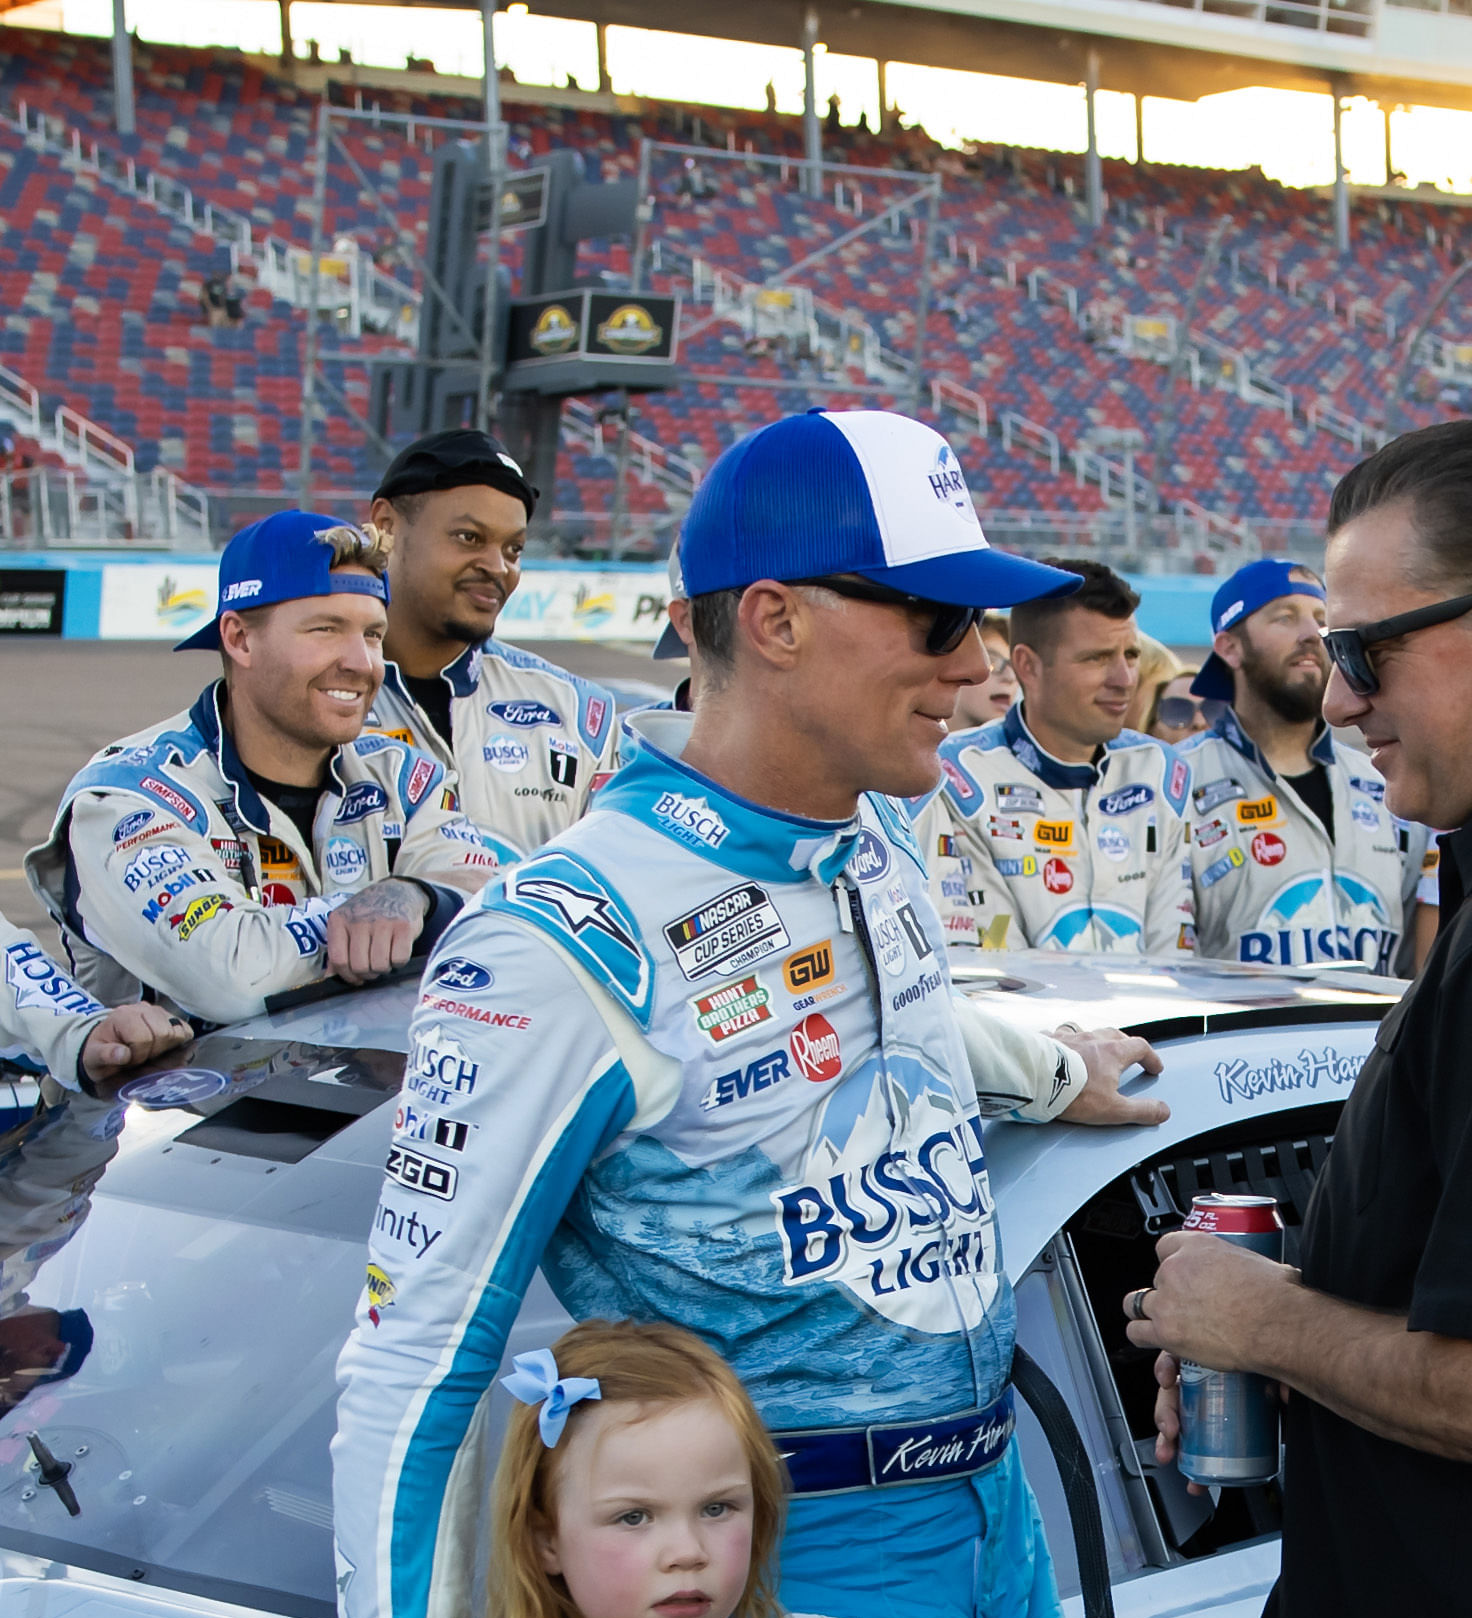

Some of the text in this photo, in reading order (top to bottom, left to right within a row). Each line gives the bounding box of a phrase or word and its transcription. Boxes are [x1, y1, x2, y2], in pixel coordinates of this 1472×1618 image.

[502, 701, 551, 723] Ford
[482, 745, 529, 763] BUSCH
[548, 736, 579, 754] Mobil
[556, 754, 568, 783] 1
[145, 780, 194, 819] SIMPSON
[336, 790, 382, 822] Ford
[1105, 787, 1149, 814] Ford
[1240, 800, 1274, 820] GW
[118, 814, 148, 840] Ford
[655, 795, 728, 846] BUSCH
[660, 816, 706, 848] LIGHT
[1037, 823, 1071, 843] GW
[124, 847, 193, 893] BUSCH
[146, 864, 184, 889] LIGHT
[142, 868, 212, 925] Mobil 1
[698, 890, 753, 931] NASCAR
[179, 894, 226, 938] SUNOCO
[903, 908, 927, 953] 1
[694, 913, 764, 964] CUP SERIES
[730, 939, 776, 969] CHAMPION
[789, 948, 831, 987] GW
[882, 944, 903, 966] LIGHT
[7, 941, 106, 1017] BUSCH
[699, 989, 768, 1028] BROTHERS
[707, 983, 746, 1011] HUNT
[792, 984, 847, 1012] GEARWRENCH
[719, 1009, 761, 1036] PIZZA
[792, 1013, 841, 1080] Rheem
[408, 1077, 453, 1106] LIGHT
[700, 1050, 792, 1112] 4EVER
[1214, 1056, 1300, 1104] Kevin
[443, 1121, 458, 1147] 1
[777, 1116, 990, 1282] BUSCH
[869, 1230, 987, 1297] LIGHT
[882, 1434, 965, 1476] Kevin
